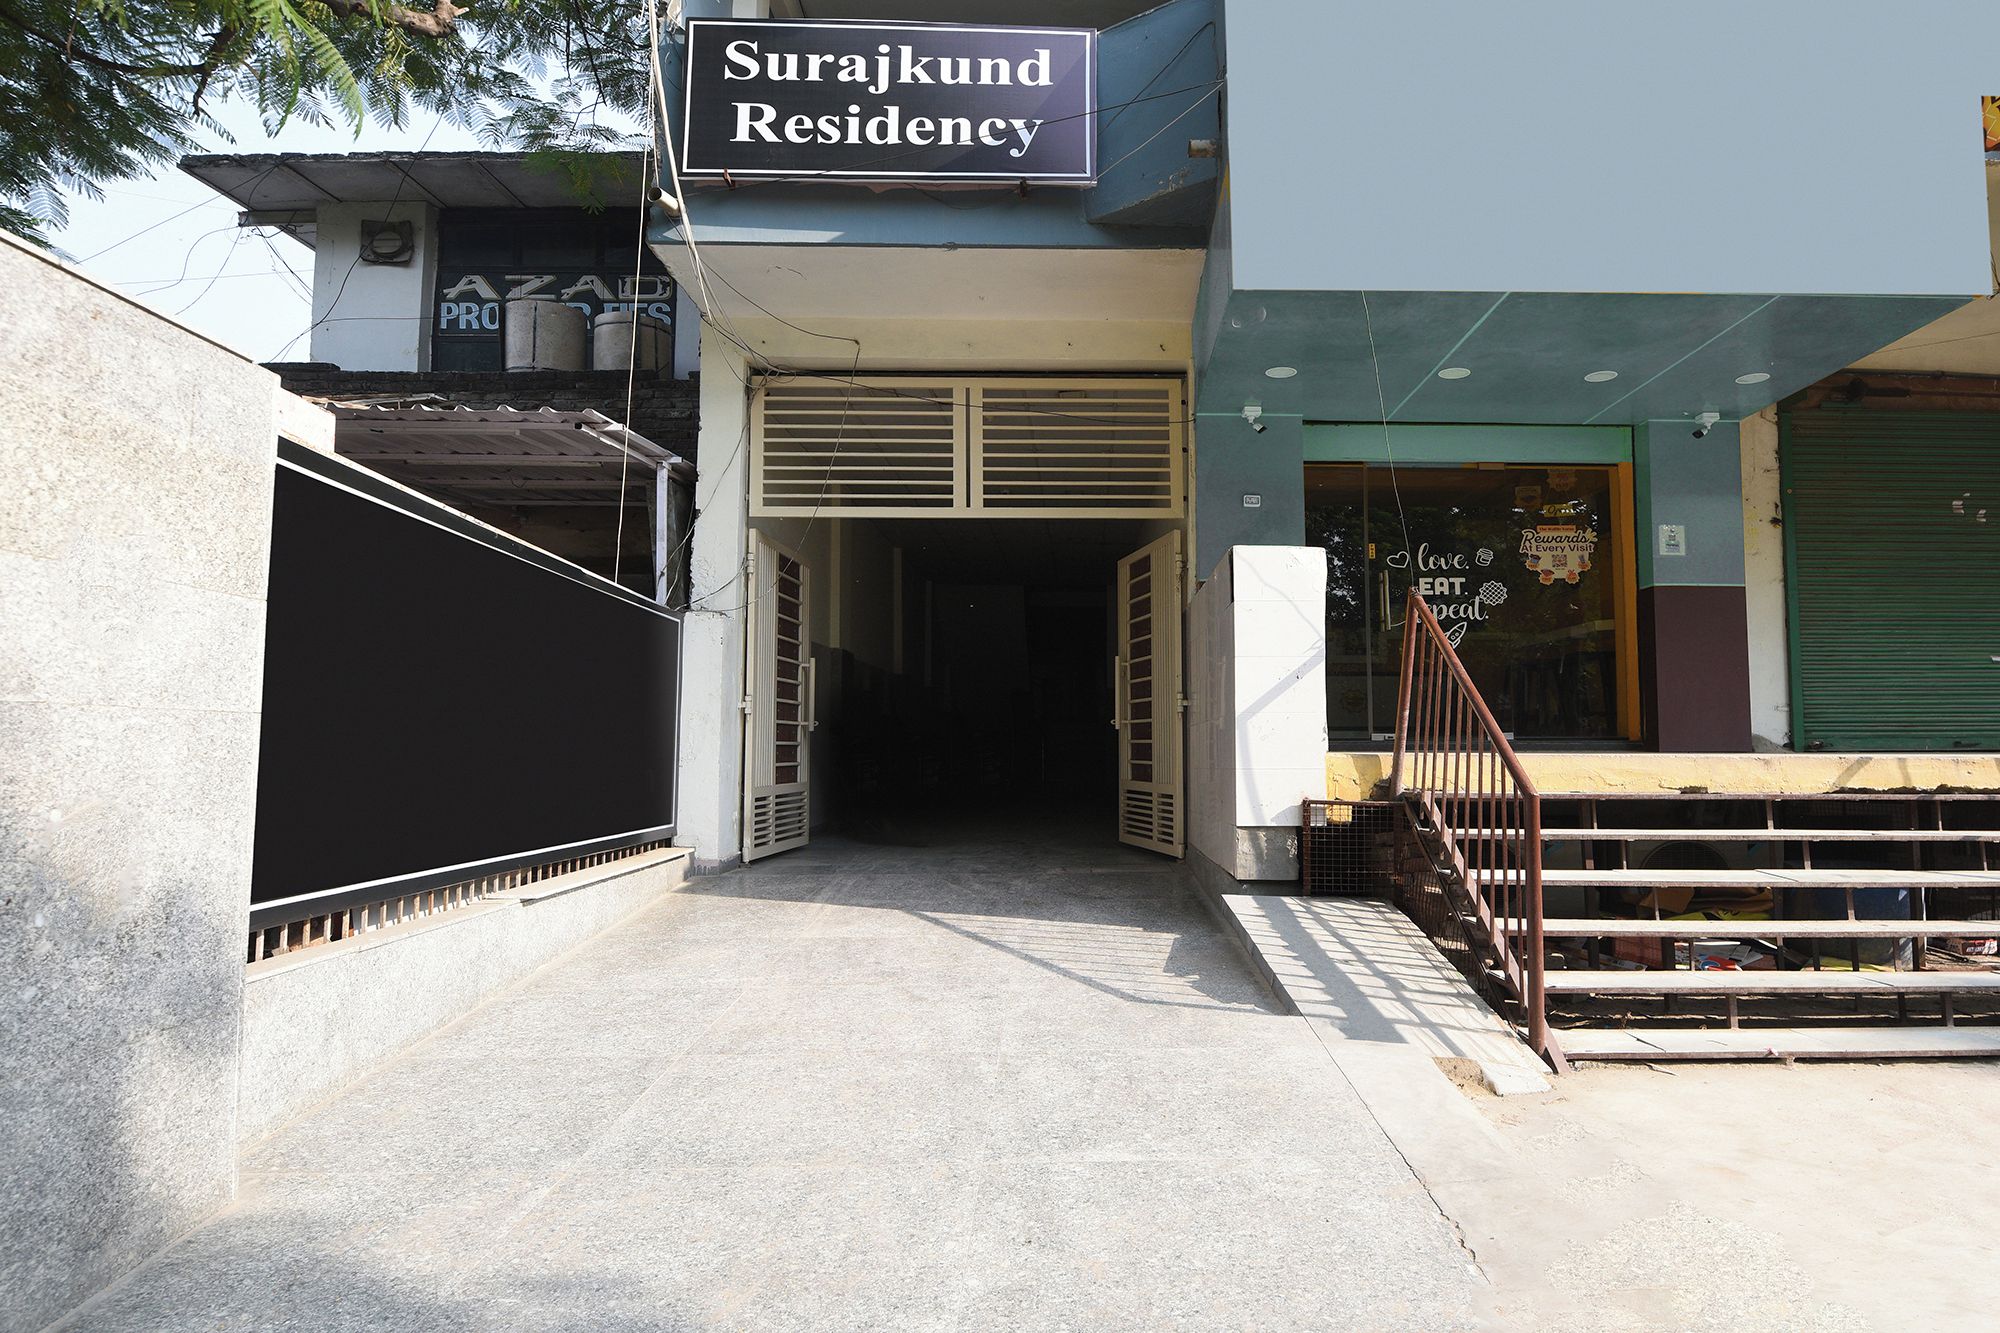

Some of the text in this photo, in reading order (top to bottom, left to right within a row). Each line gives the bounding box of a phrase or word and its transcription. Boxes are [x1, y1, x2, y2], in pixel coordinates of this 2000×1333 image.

[724, 40, 1053, 94] Surajkund
[730, 102, 1044, 157] Residency
[443, 274, 674, 301] AZAD
[1523, 530, 1589, 545] Rewards
[1536, 545, 1565, 553] Every
[1568, 544, 1593, 552] Visit
[1418, 577, 1469, 595] EAT.
